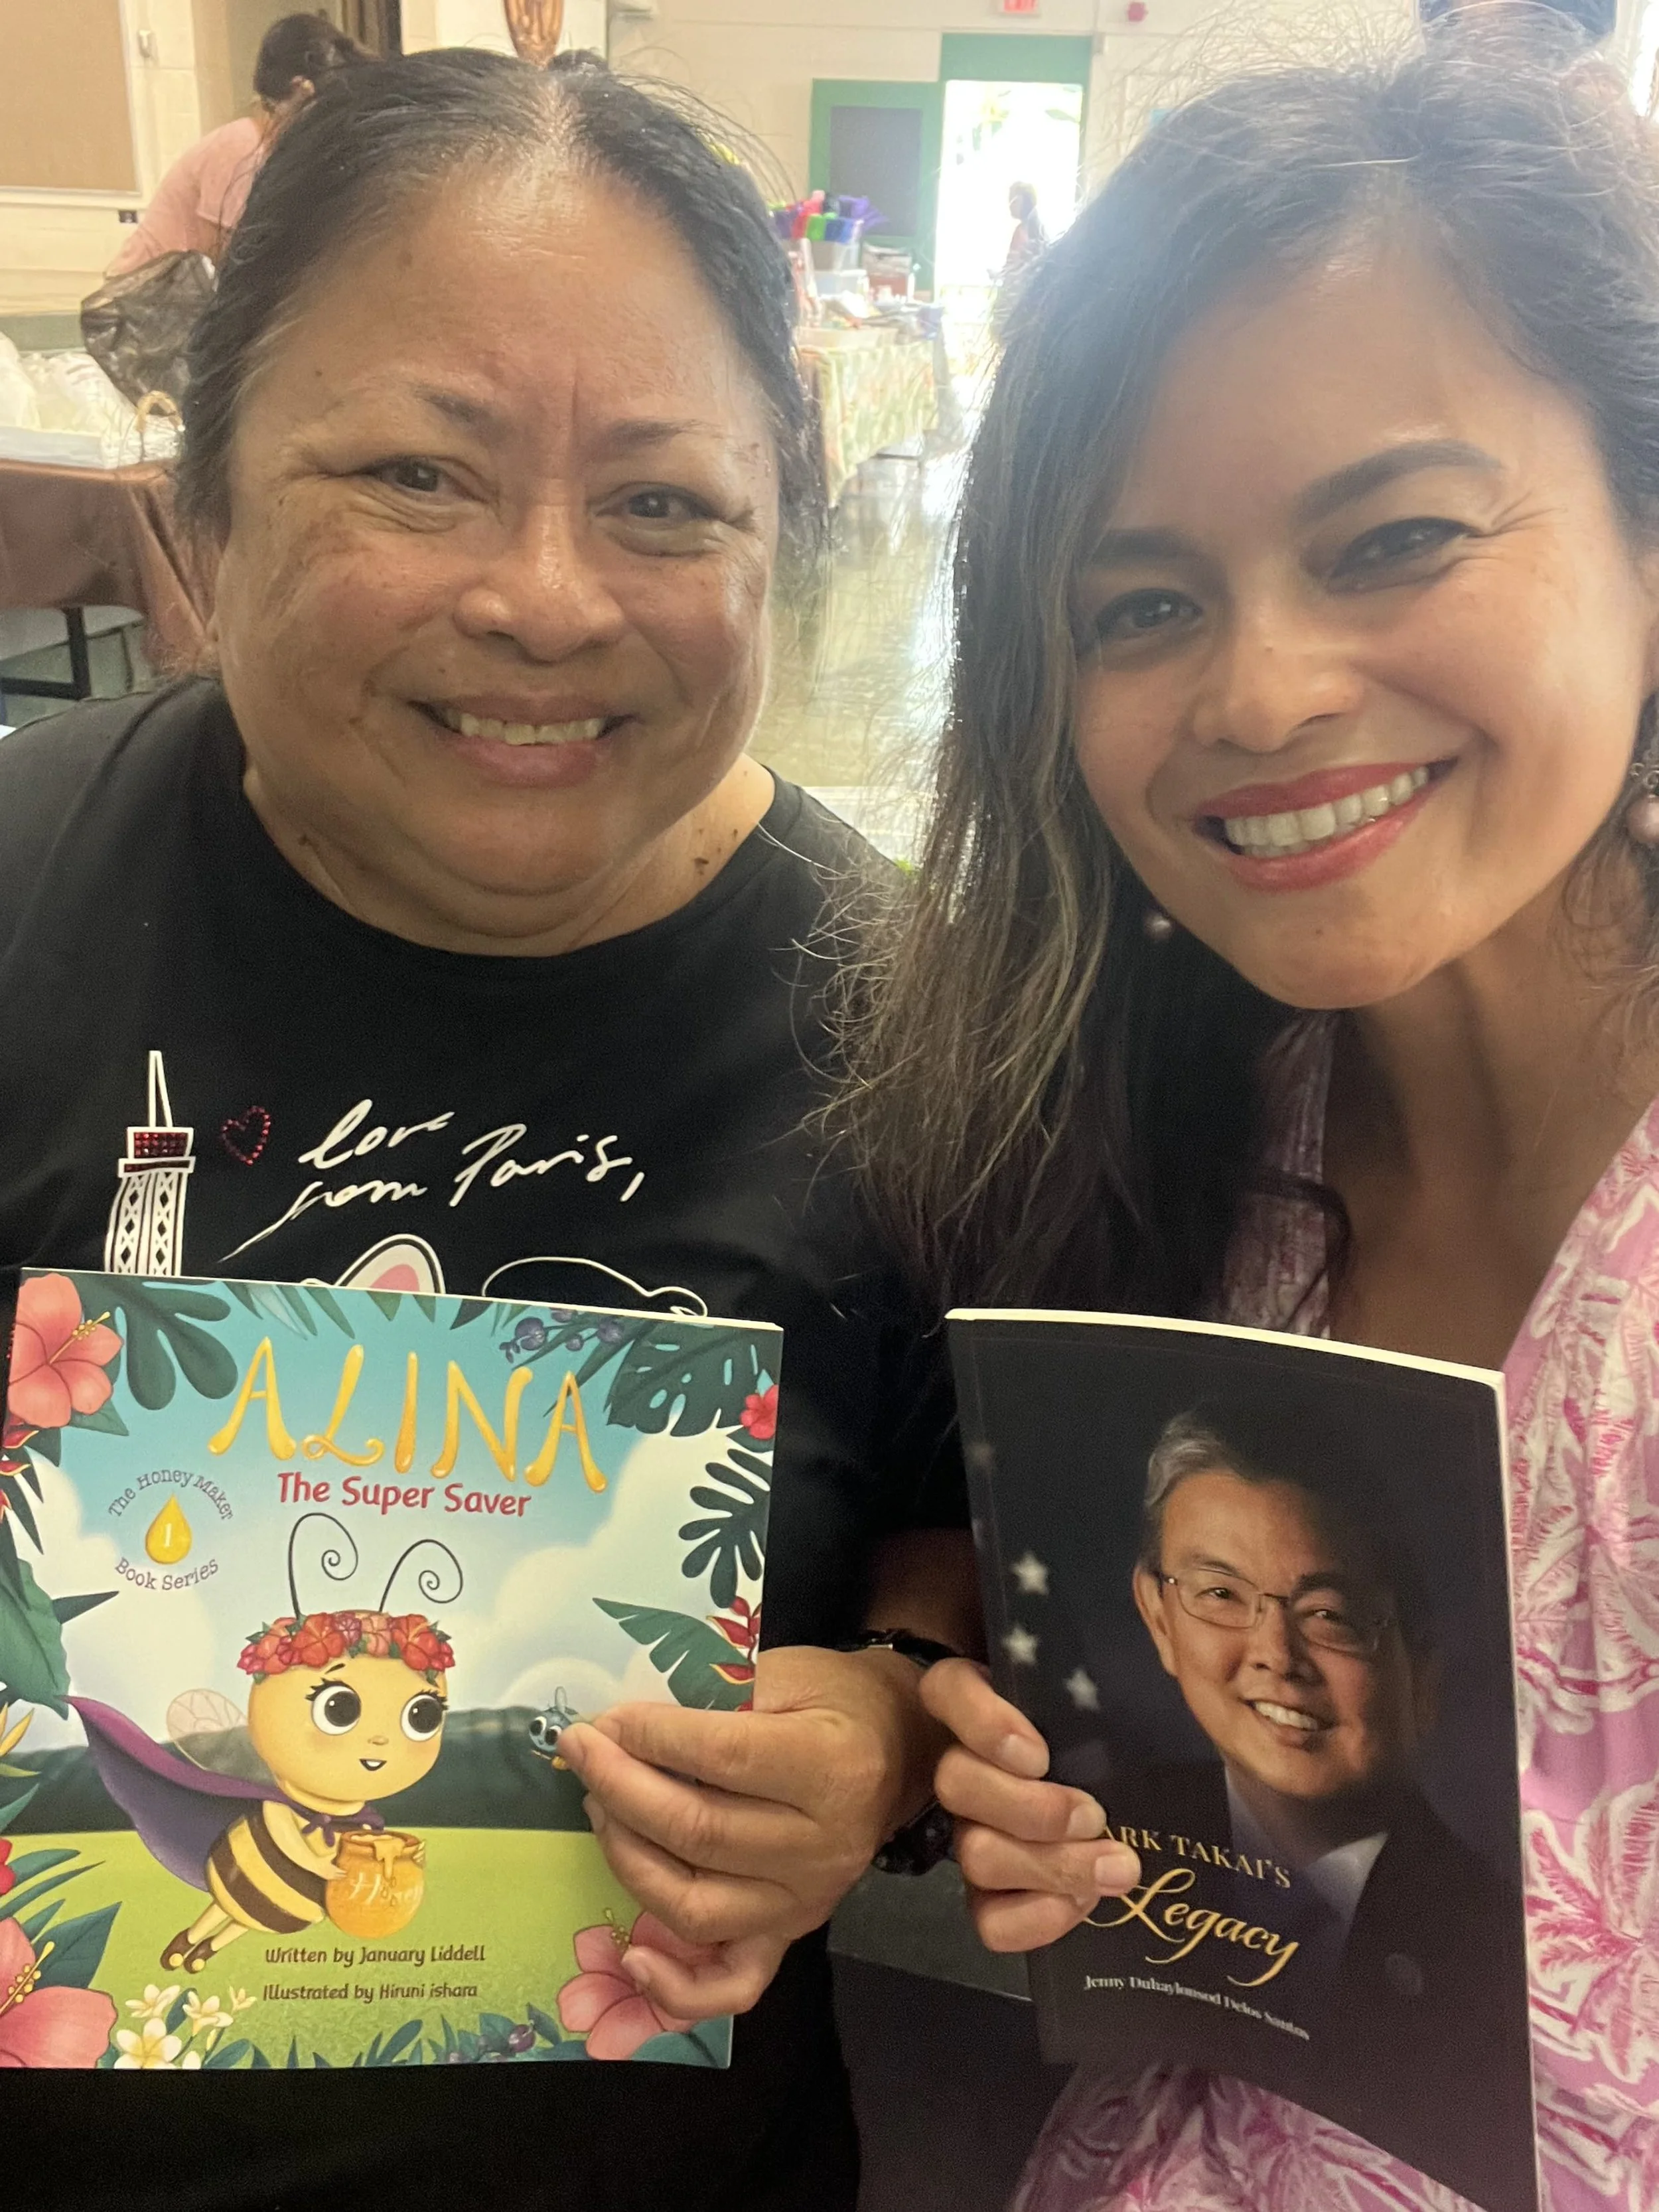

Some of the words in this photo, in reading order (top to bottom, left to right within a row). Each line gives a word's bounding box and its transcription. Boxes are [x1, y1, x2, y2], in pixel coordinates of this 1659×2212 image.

[206, 1335, 608, 1493] ALINA
[108, 1487, 137, 1518] The
[136, 1469, 194, 1491] Honey
[192, 1475, 234, 1520] Maker
[277, 1471, 331, 1503] The
[342, 1475, 435, 1515] Super
[444, 1483, 532, 1516] Saver
[115, 1558, 157, 1590] Book
[162, 1558, 219, 1591] Series
[1083, 1868, 1299, 1988] Legacy
[265, 1947, 327, 1963] Written
[333, 1947, 354, 1968] by
[358, 1946, 425, 1967] January
[431, 1945, 486, 1962] Liddell
[263, 1982, 348, 2000] Illustrated
[354, 1983, 374, 2004] by
[380, 1983, 425, 1999] Hiruni
[1084, 1975, 1125, 1990] Jenny
